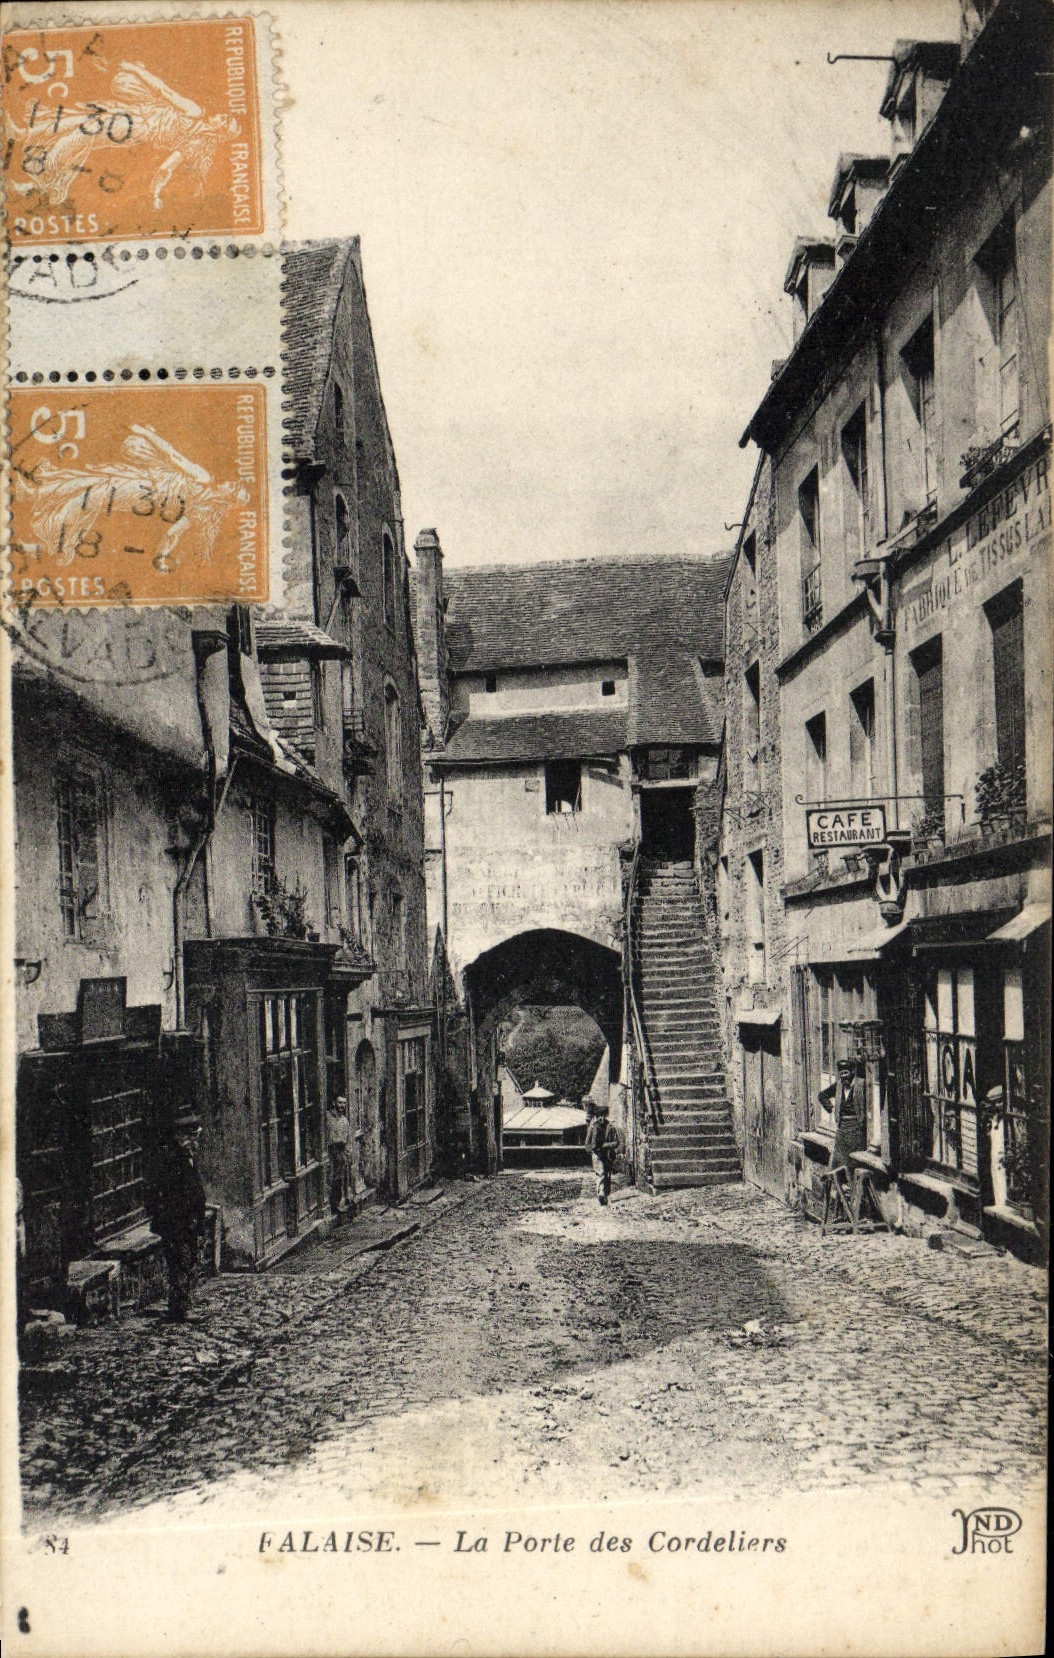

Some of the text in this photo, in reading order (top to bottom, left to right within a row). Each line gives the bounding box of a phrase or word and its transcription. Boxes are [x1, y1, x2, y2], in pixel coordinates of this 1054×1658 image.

[225, 26, 244, 115] REPUBLIQUE
[14, 213, 99, 236] POSTES
[236, 394, 255, 483] REPUBLIQUE
[20, 576, 105, 599] POSTES
[817, 812, 872, 829] CAFE
[813, 827, 881, 843] RESTAURANT
